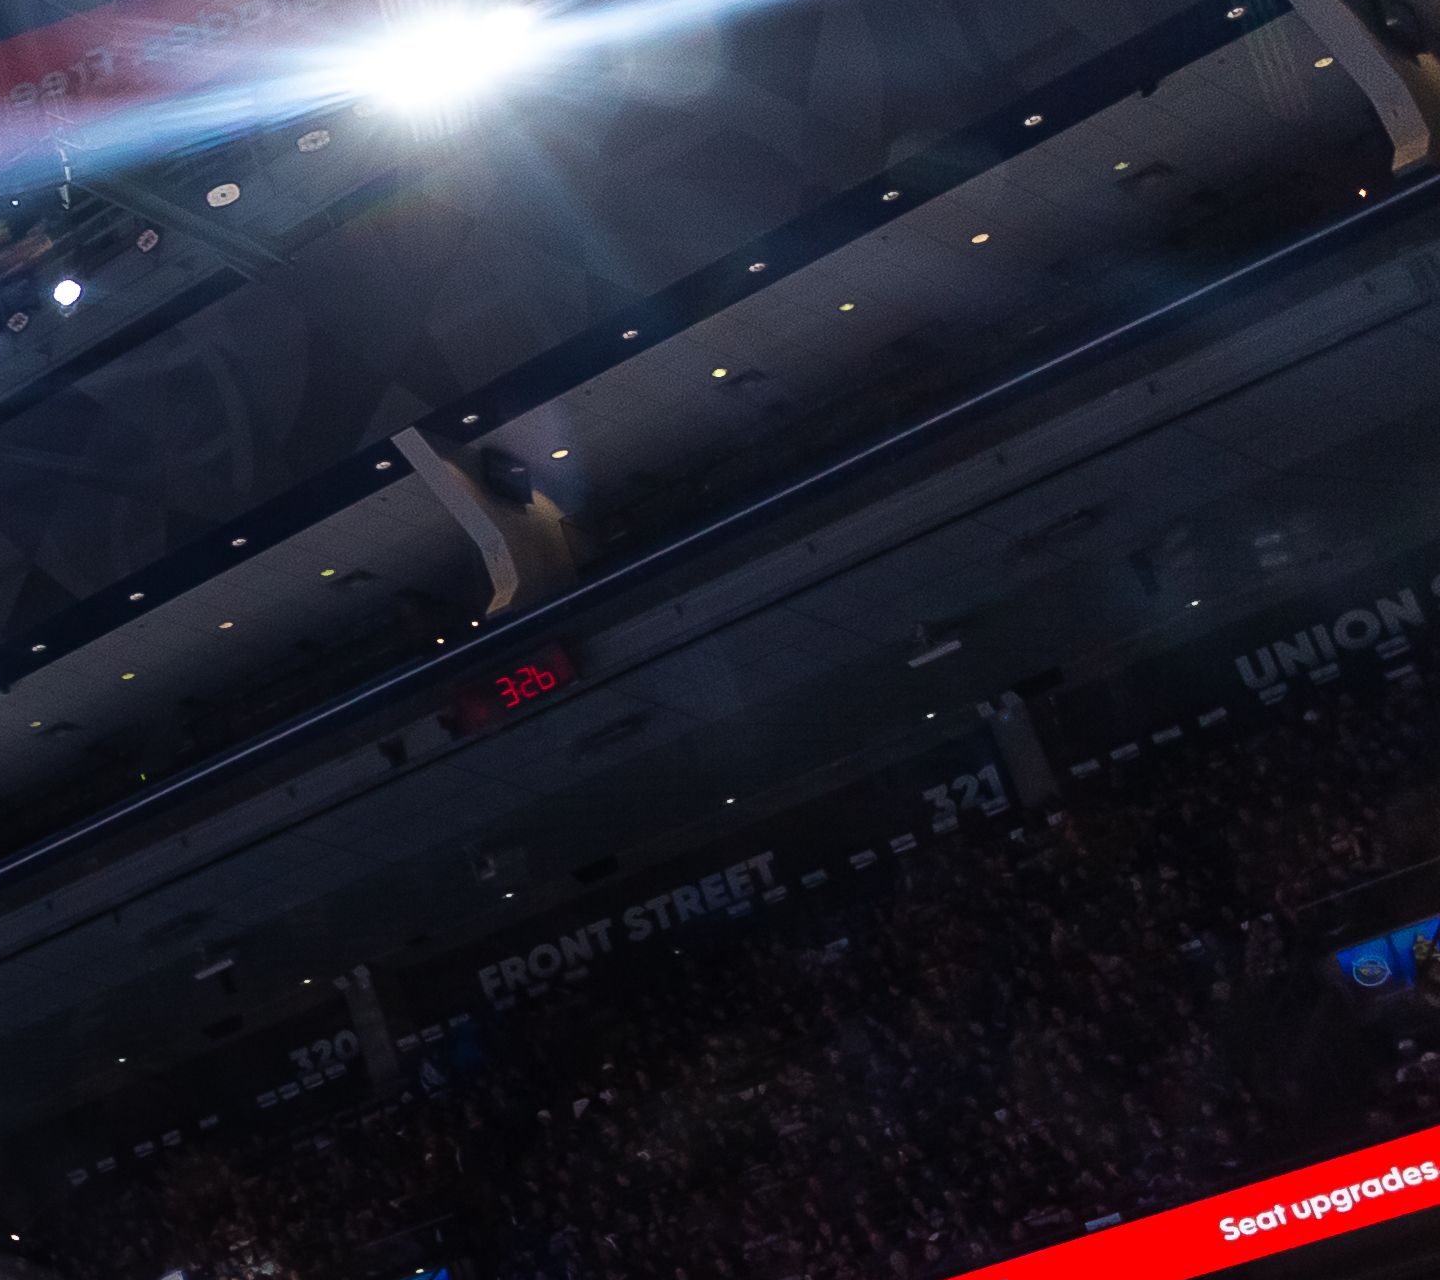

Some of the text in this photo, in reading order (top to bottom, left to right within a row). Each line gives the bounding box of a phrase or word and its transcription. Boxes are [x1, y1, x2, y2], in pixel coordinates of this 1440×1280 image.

[1234, 586, 1426, 693] UNION
[921, 762, 1010, 824] 321
[478, 849, 779, 1004] FRONT STREET
[287, 1027, 363, 1075] 320
[1218, 1203, 1289, 1242] Seat
